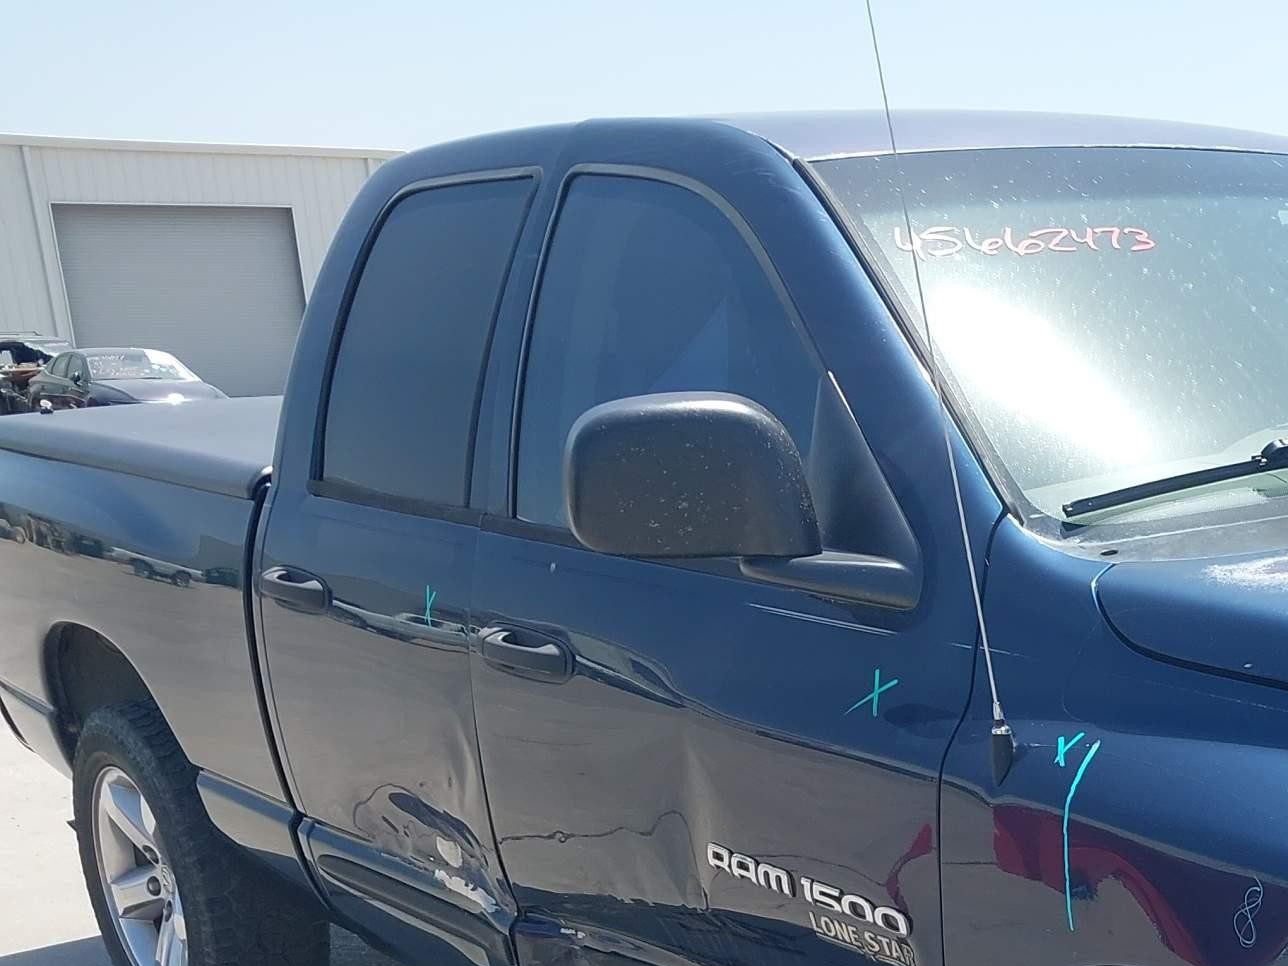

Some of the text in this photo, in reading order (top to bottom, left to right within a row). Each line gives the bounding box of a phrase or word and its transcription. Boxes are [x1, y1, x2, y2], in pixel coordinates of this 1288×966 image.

[894, 226, 1156, 261] 45662473
[707, 842, 913, 937] RAM 1500
[808, 911, 862, 947] LONE
